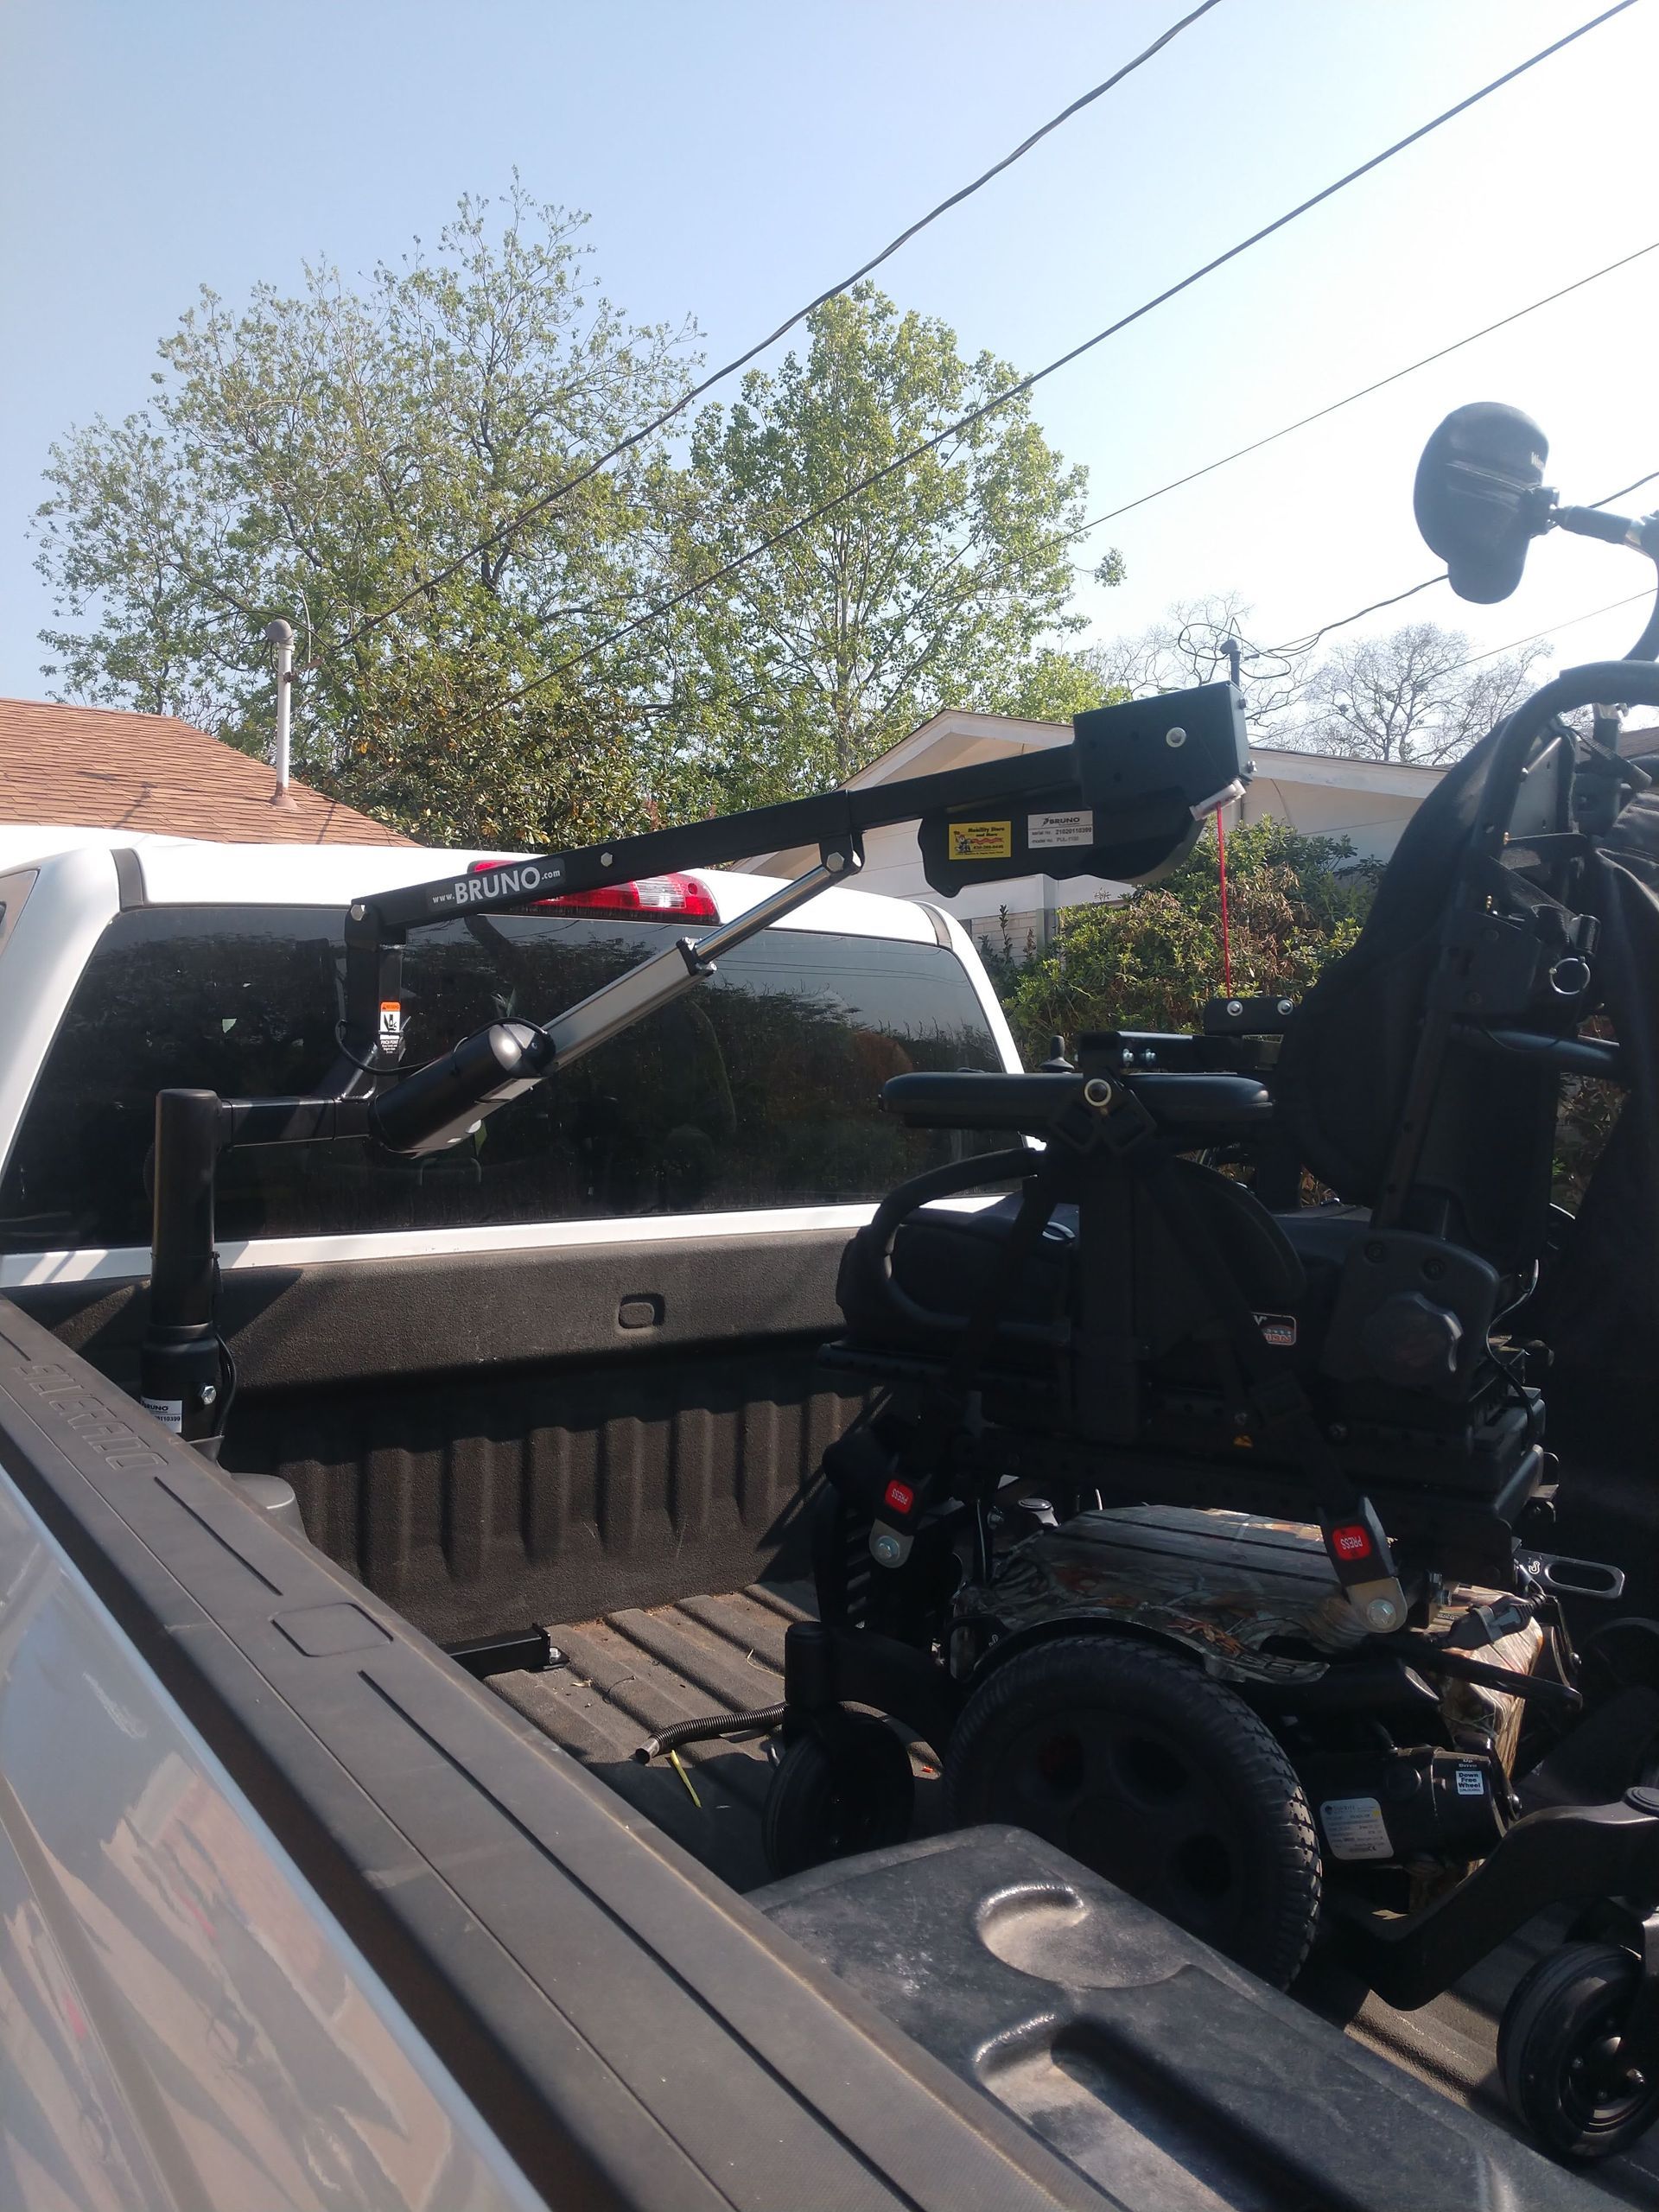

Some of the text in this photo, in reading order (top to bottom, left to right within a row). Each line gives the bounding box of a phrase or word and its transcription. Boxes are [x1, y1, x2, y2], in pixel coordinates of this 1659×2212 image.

[432, 866, 561, 905] www.BRUNO.com
[12, 1363, 169, 1471] SILVERADO
[891, 1487, 909, 1505] PRESS
[1340, 1535, 1363, 1550] PRESS
